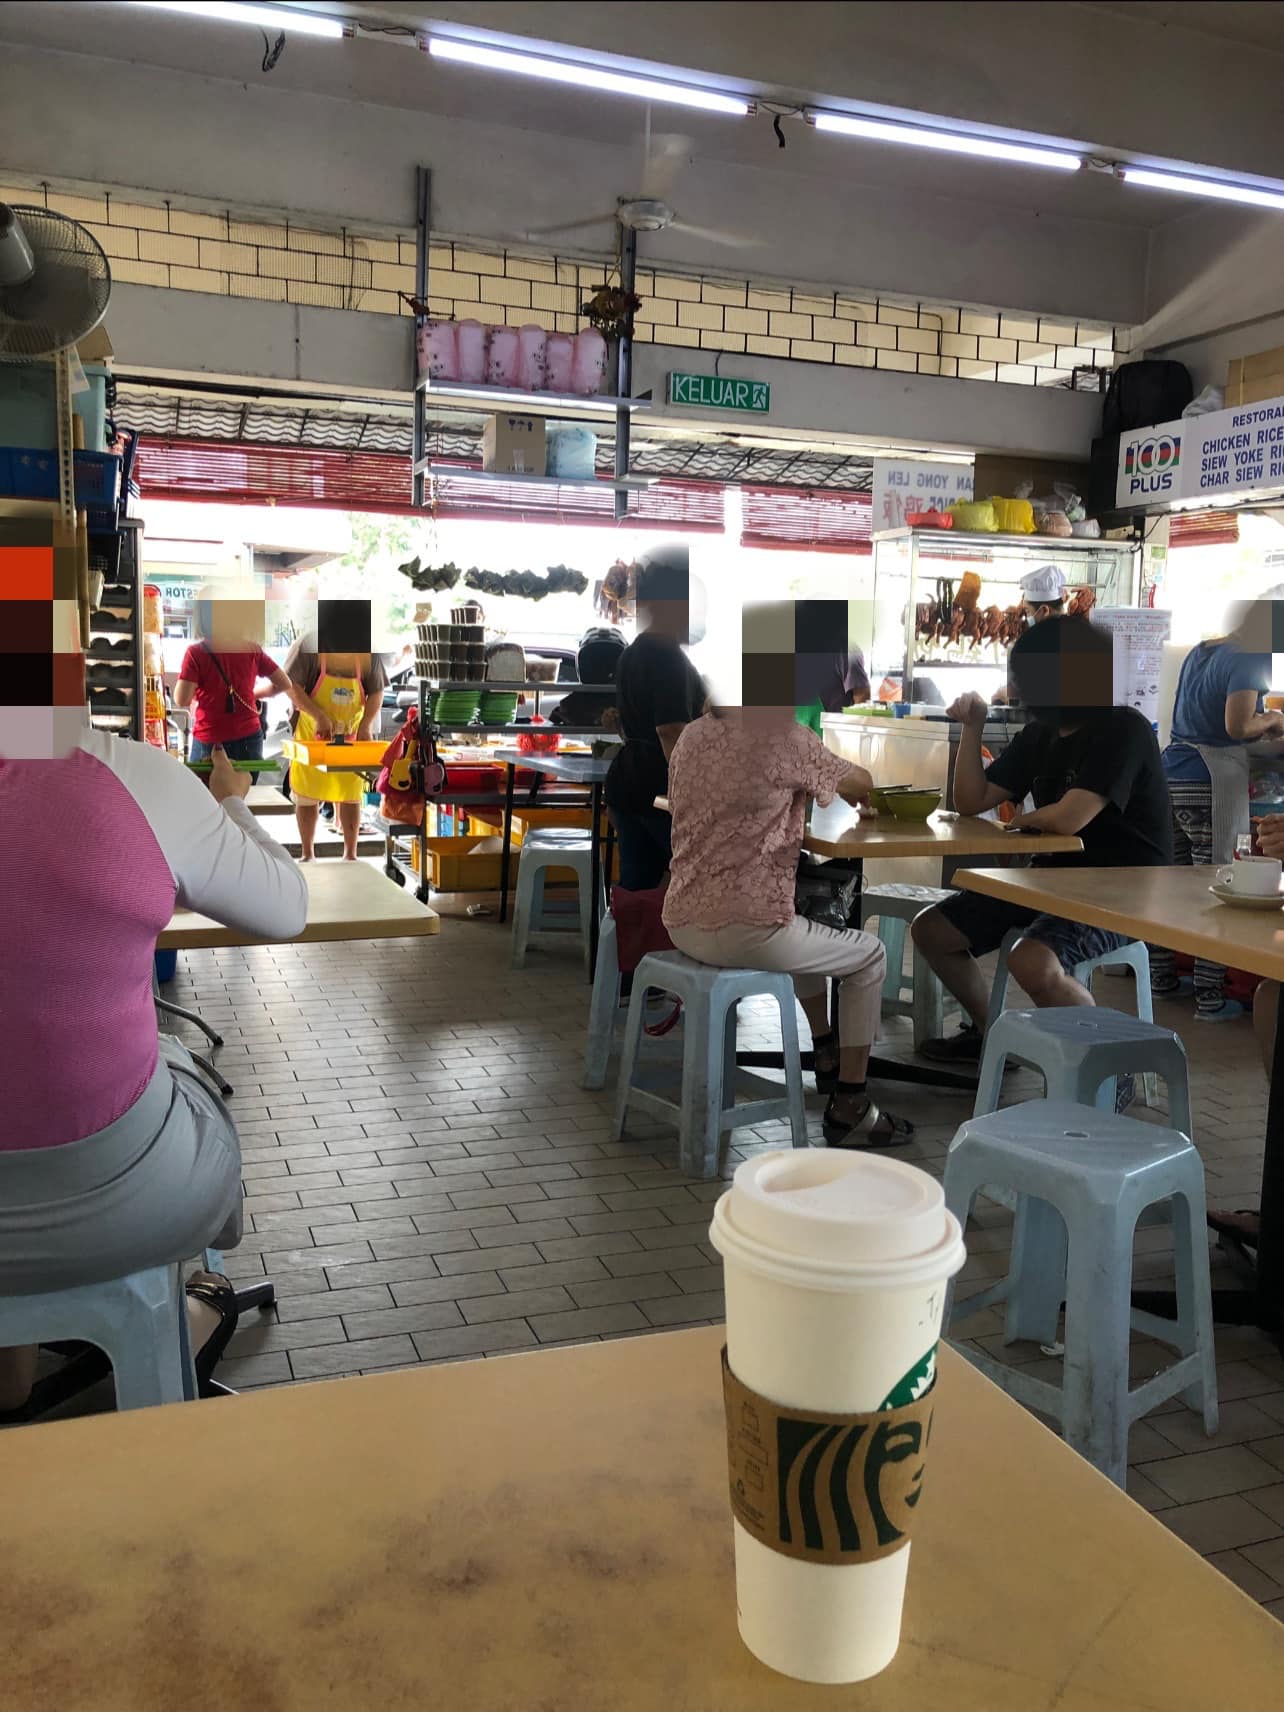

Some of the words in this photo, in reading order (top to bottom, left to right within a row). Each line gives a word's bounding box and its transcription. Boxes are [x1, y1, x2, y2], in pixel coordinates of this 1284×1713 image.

[675, 375, 748, 408] KELUAR
[1202, 433, 1251, 455] CHICKEN
[1257, 426, 1284, 445] RICE
[1130, 434, 1176, 478] 100
[1201, 454, 1228, 472] SIEW
[1234, 447, 1264, 466] YOKE
[1130, 473, 1172, 494] PLUS
[1200, 470, 1229, 488] CHAR
[1235, 465, 1264, 482] SIEW
